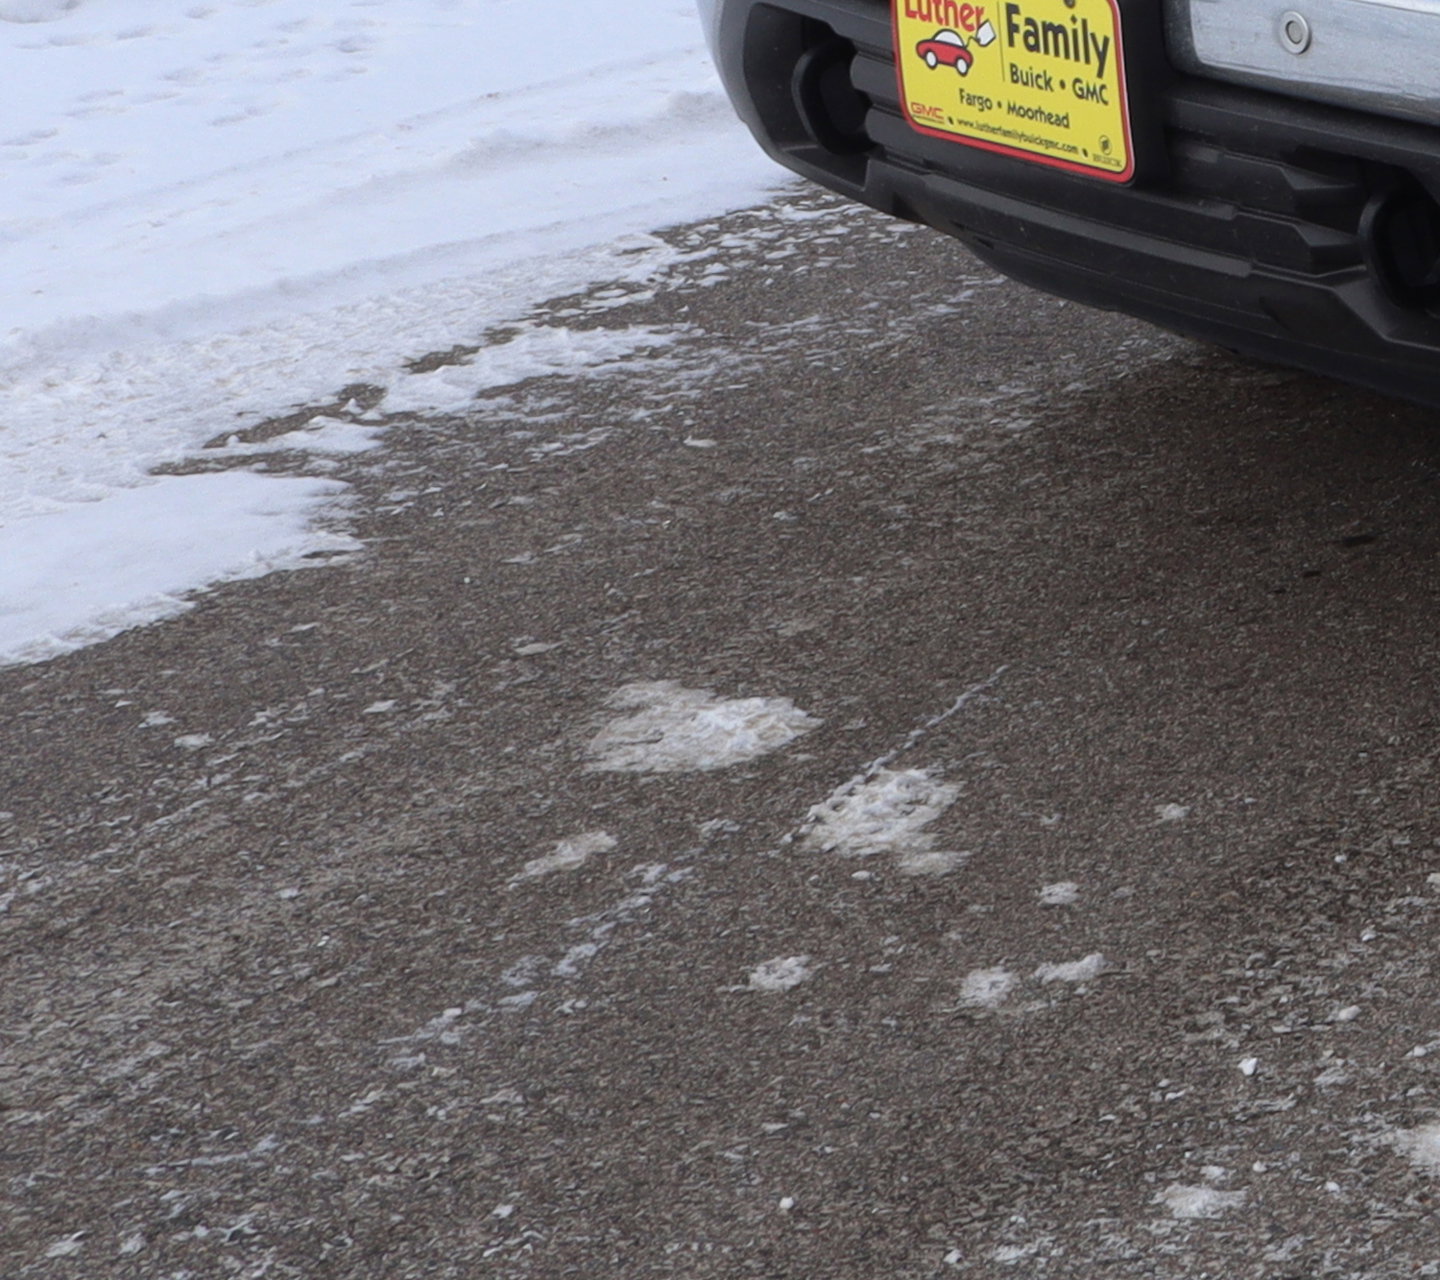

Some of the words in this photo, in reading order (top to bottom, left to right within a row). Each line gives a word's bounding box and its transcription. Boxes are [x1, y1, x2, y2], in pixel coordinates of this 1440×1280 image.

[1005, 2, 1110, 80] Family
[1009, 62, 1055, 93] Buick
[1072, 76, 1110, 106] GMC
[958, 88, 993, 113] Fargo
[1006, 102, 1070, 130] Moorhead
